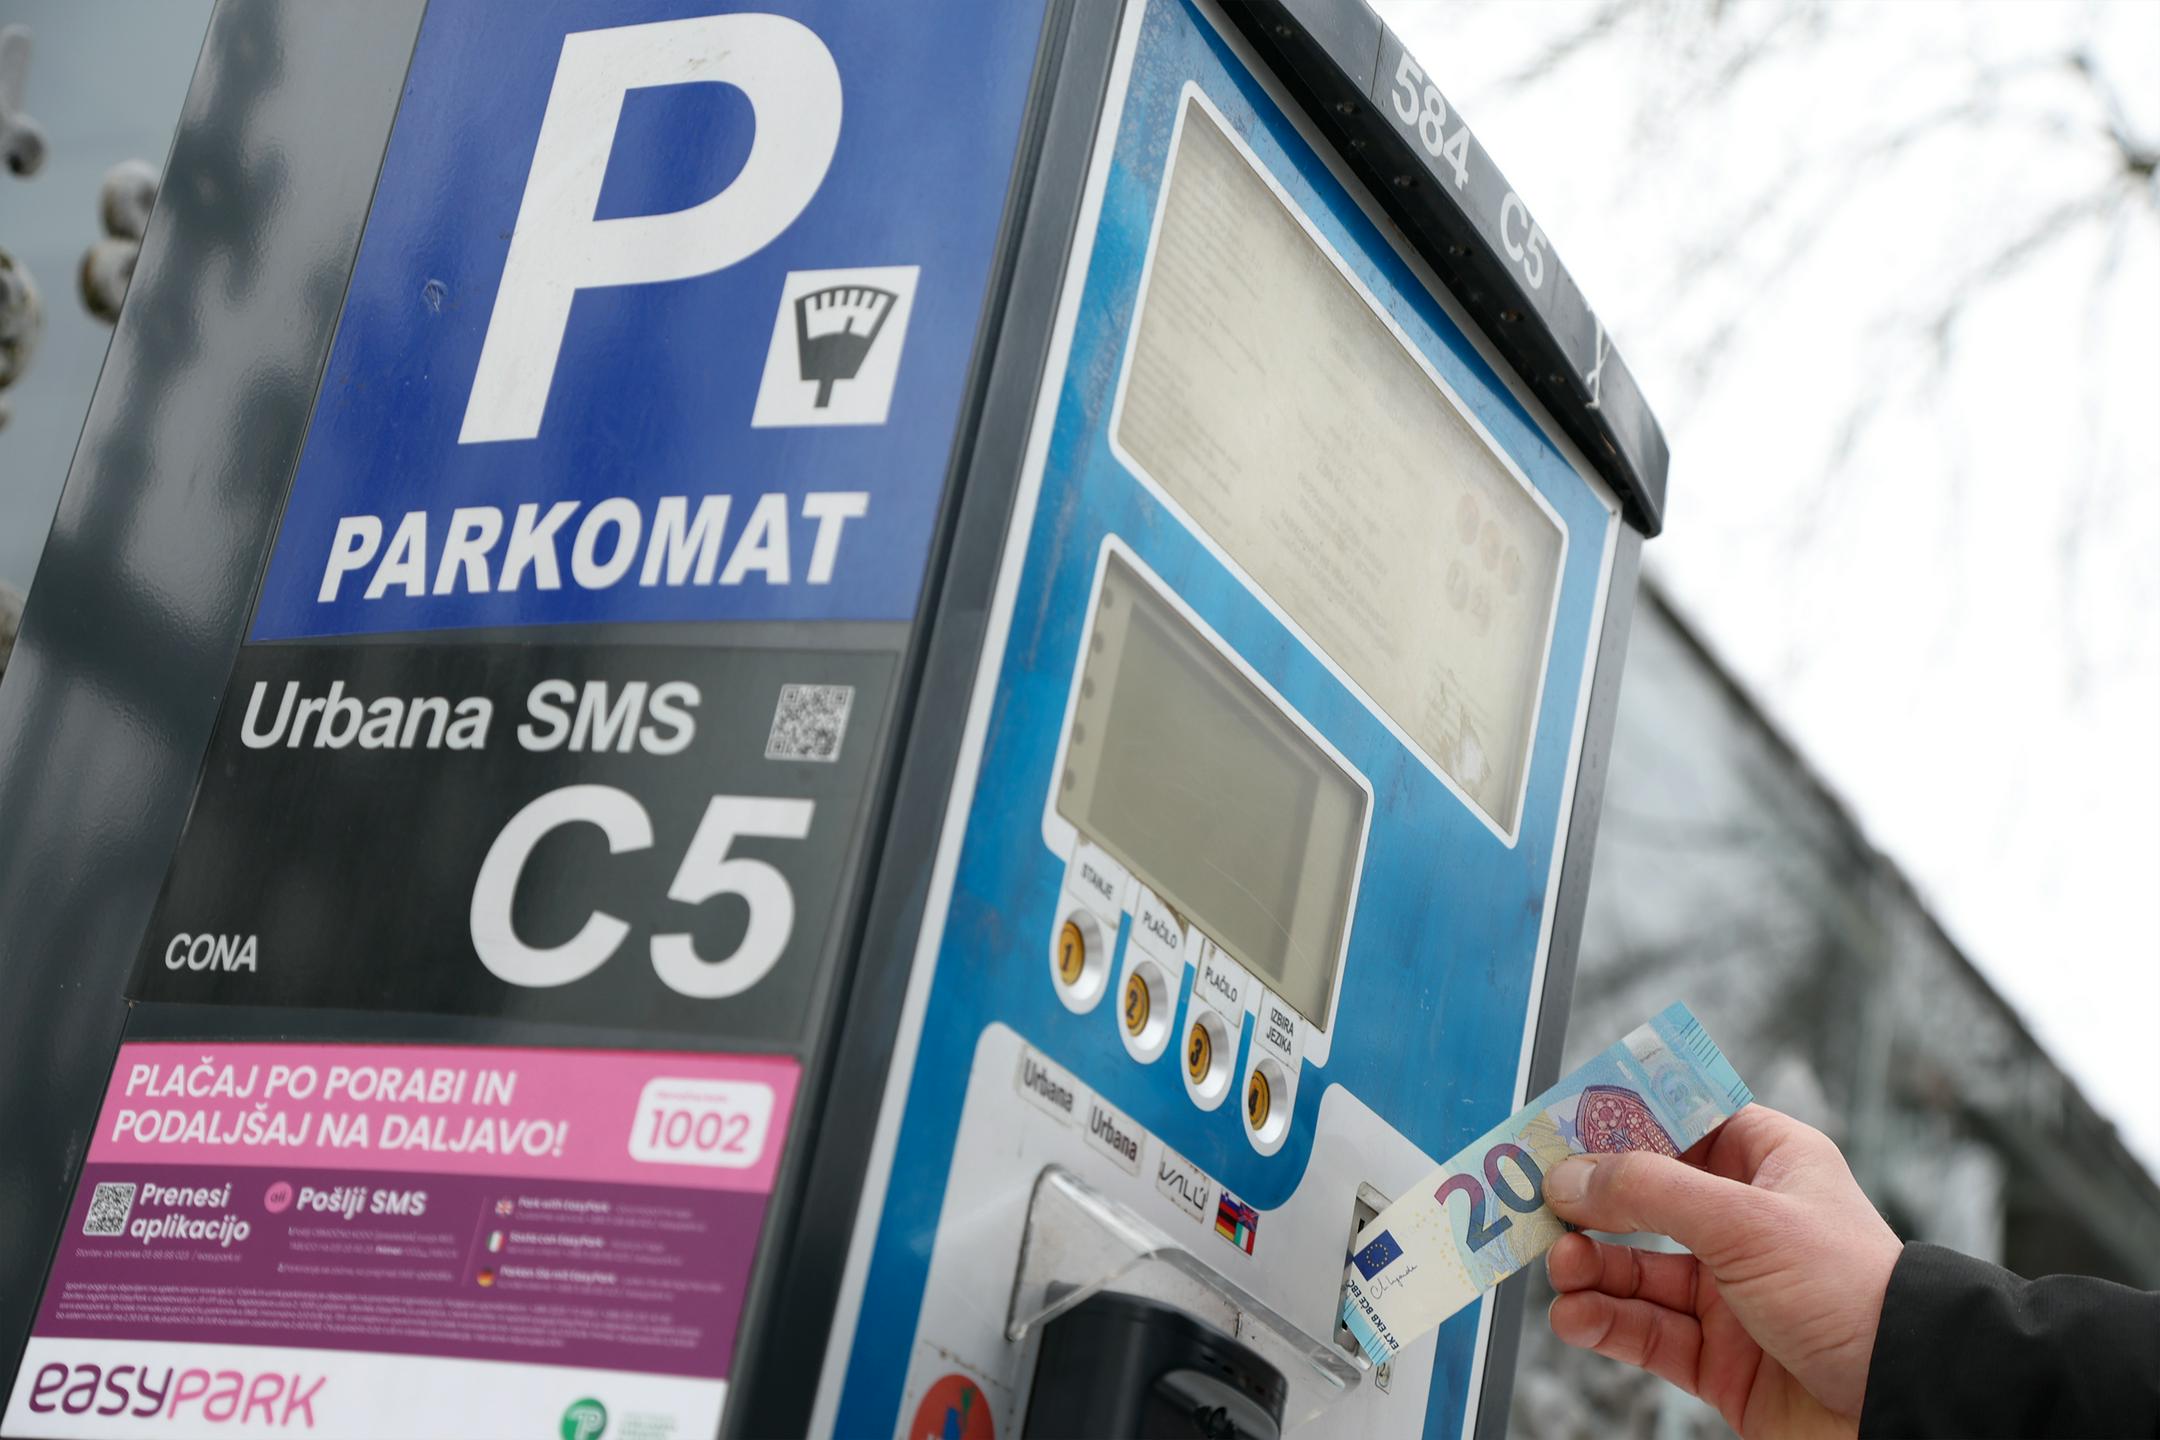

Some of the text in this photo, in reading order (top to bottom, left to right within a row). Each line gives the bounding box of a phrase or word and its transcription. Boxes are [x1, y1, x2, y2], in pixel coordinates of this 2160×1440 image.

[1391, 52, 1471, 191] 584
[458, 12, 843, 444] P
[1500, 191, 1547, 290] C5
[317, 491, 870, 603] PARKOMAT
[240, 679, 701, 756] Urbana SMS
[469, 784, 815, 999] C5
[1080, 863, 1114, 900] STANJE
[1143, 911, 1177, 950] PLAČILO
[164, 932, 259, 973] CONA
[1060, 944, 1073, 973] 1
[1125, 988, 1139, 1021] 2
[1204, 966, 1239, 1003] PLAČILO
[1265, 1025, 1292, 1056] JEZIKA
[1270, 1006, 1294, 1037] IZBIRA
[1189, 1038, 1204, 1068] 3
[125, 1056, 517, 1107] PLAČAJ PO PORABI IN
[1023, 1058, 1074, 1114] Urbana
[111, 1102, 570, 1158] PODALJŠAJ NA DALJAVO!
[649, 1109, 752, 1153] 1002
[1090, 1104, 1139, 1162] Urbana
[139, 1182, 232, 1208] Prenesi
[296, 1186, 427, 1221] Pošlji SMS
[1434, 1143, 1546, 1254] 20
[130, 1213, 251, 1248] aplikacijo
